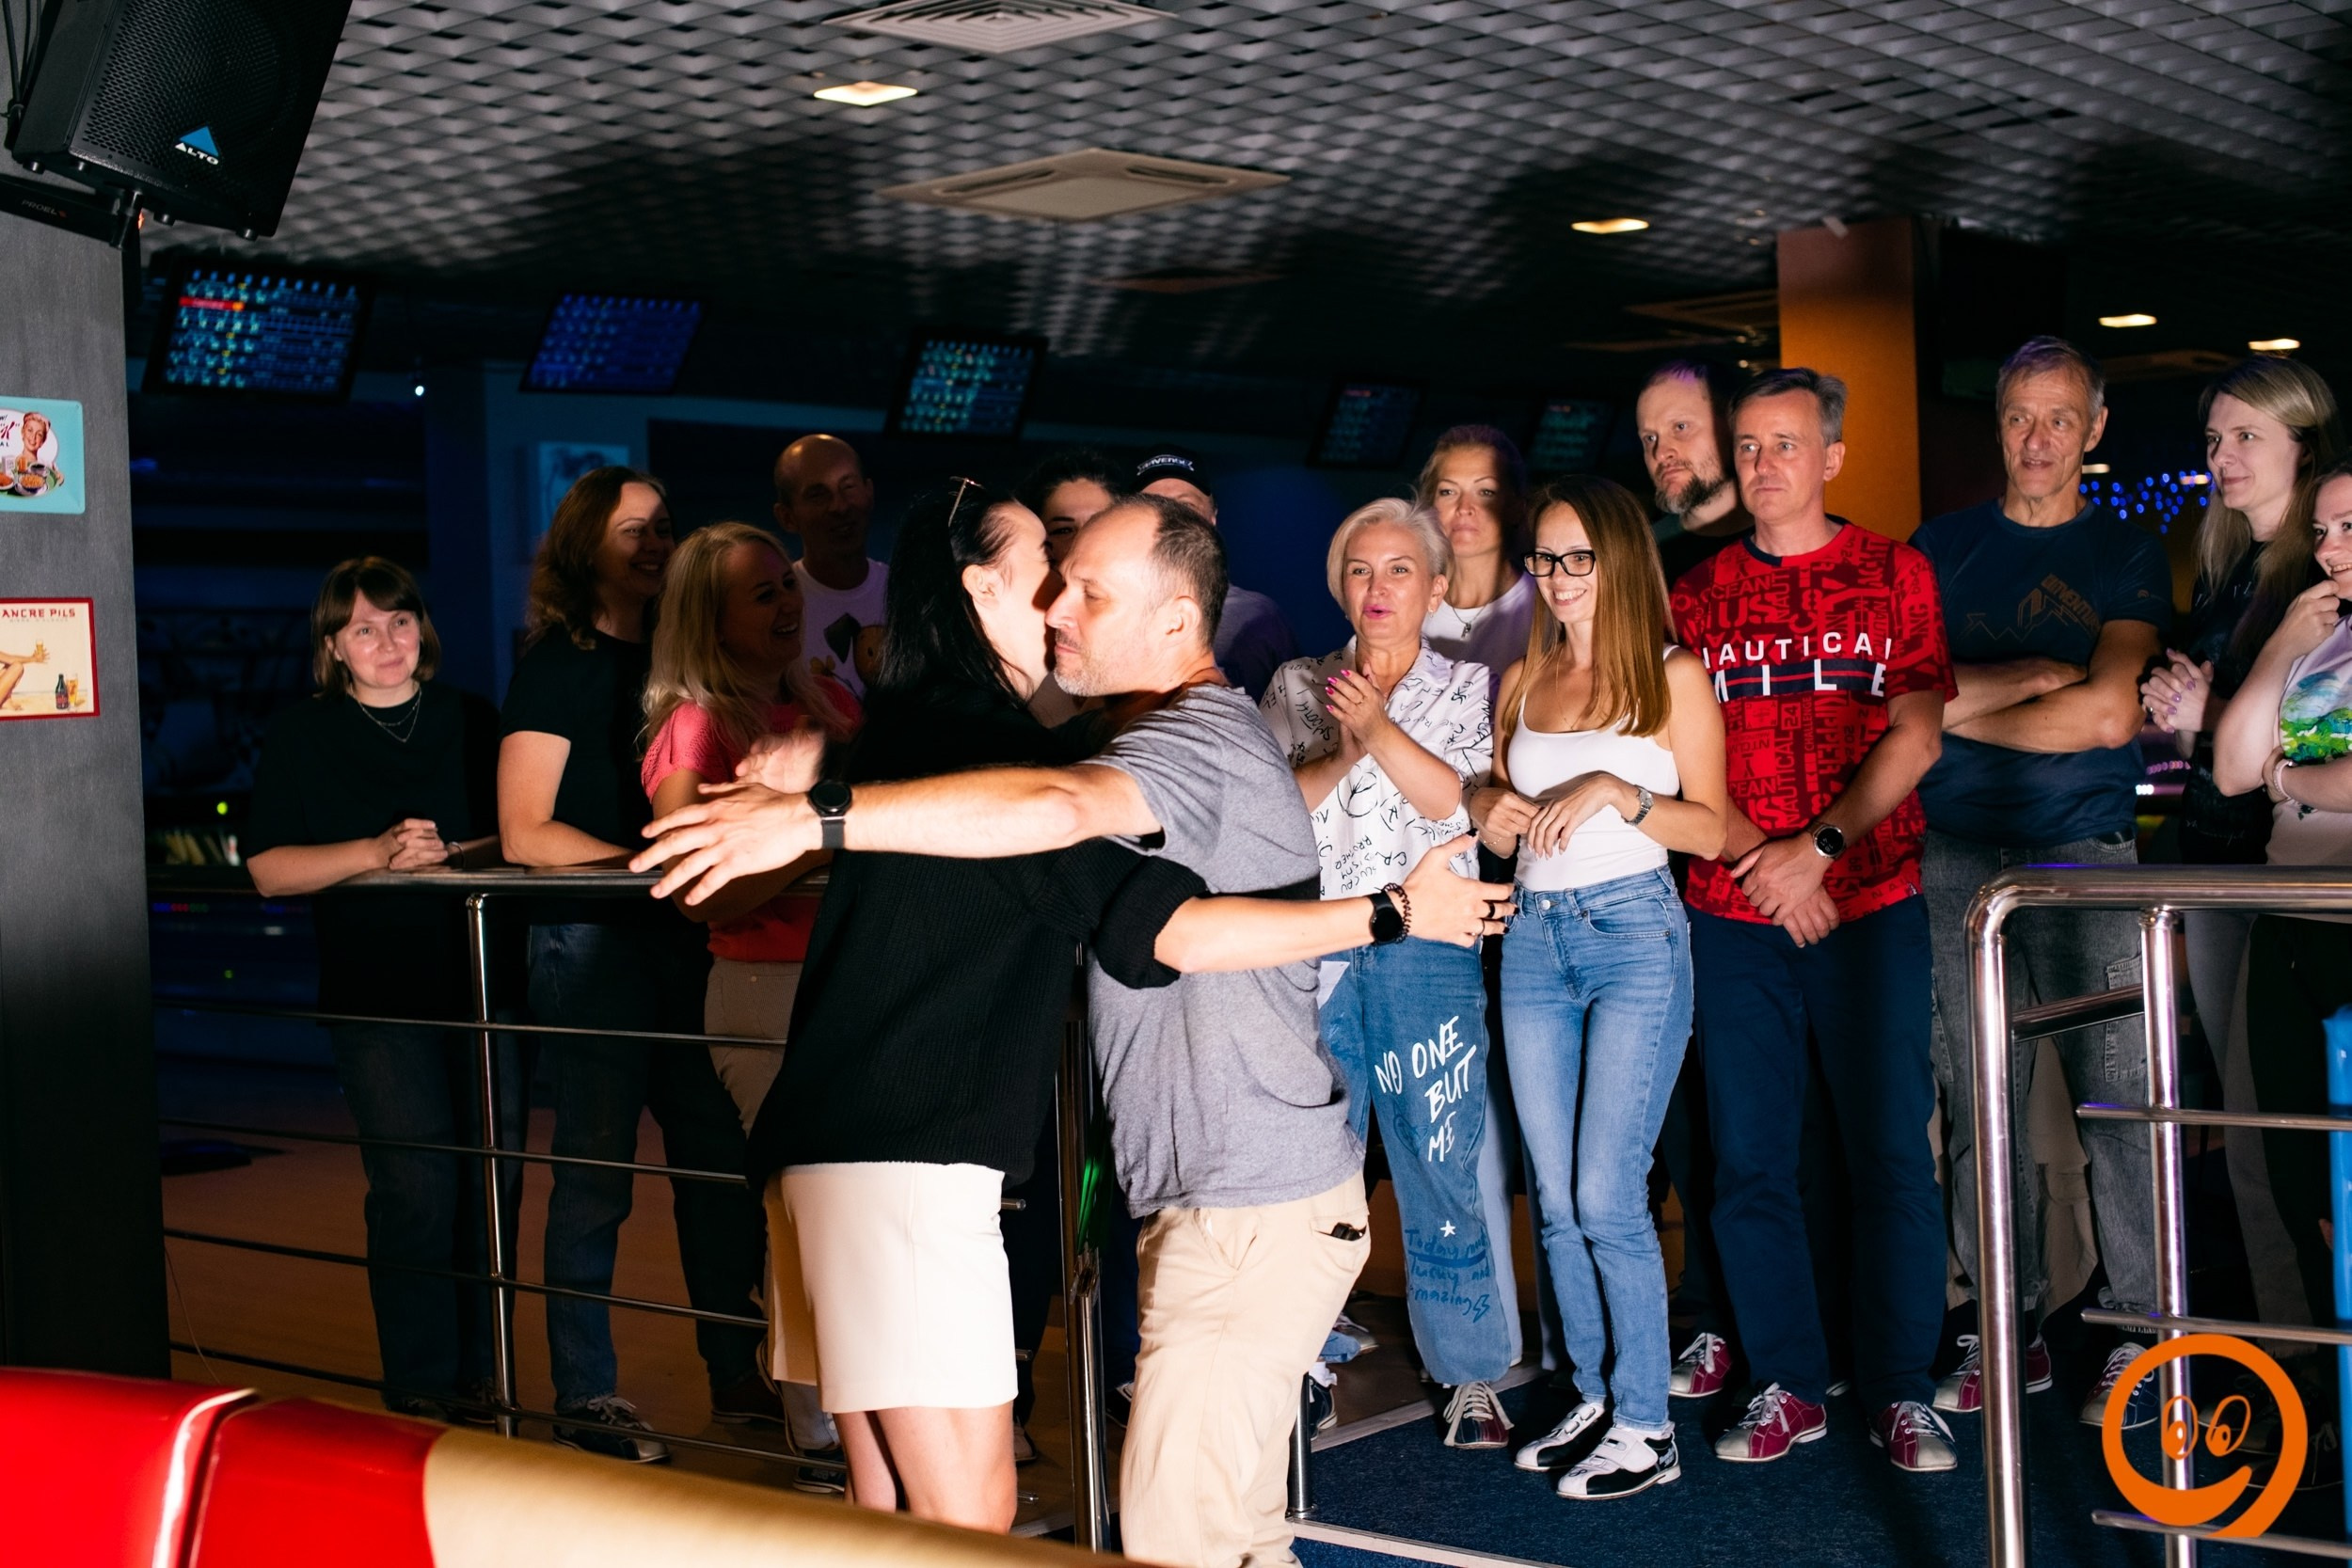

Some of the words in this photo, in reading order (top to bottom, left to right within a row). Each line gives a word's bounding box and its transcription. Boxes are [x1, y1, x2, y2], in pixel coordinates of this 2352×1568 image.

[175, 142, 218, 165] ALTO
[22, 199, 56, 214] PROEL
[2, 609, 44, 618] ANCRE
[49, 608, 75, 617] PILS
[1803, 696, 1816, 752] CHALLENGE
[1728, 778, 1776, 798] CEAN
[1774, 730, 1800, 829] NAUTICAL
[1375, 1051, 1402, 1094] NO
[1412, 1016, 1463, 1078] ONE
[1424, 1045, 1476, 1123] BUT
[1428, 1111, 1456, 1162] ME
[1405, 1229, 1459, 1259] Today
[1409, 1285, 1471, 1315] mazing
